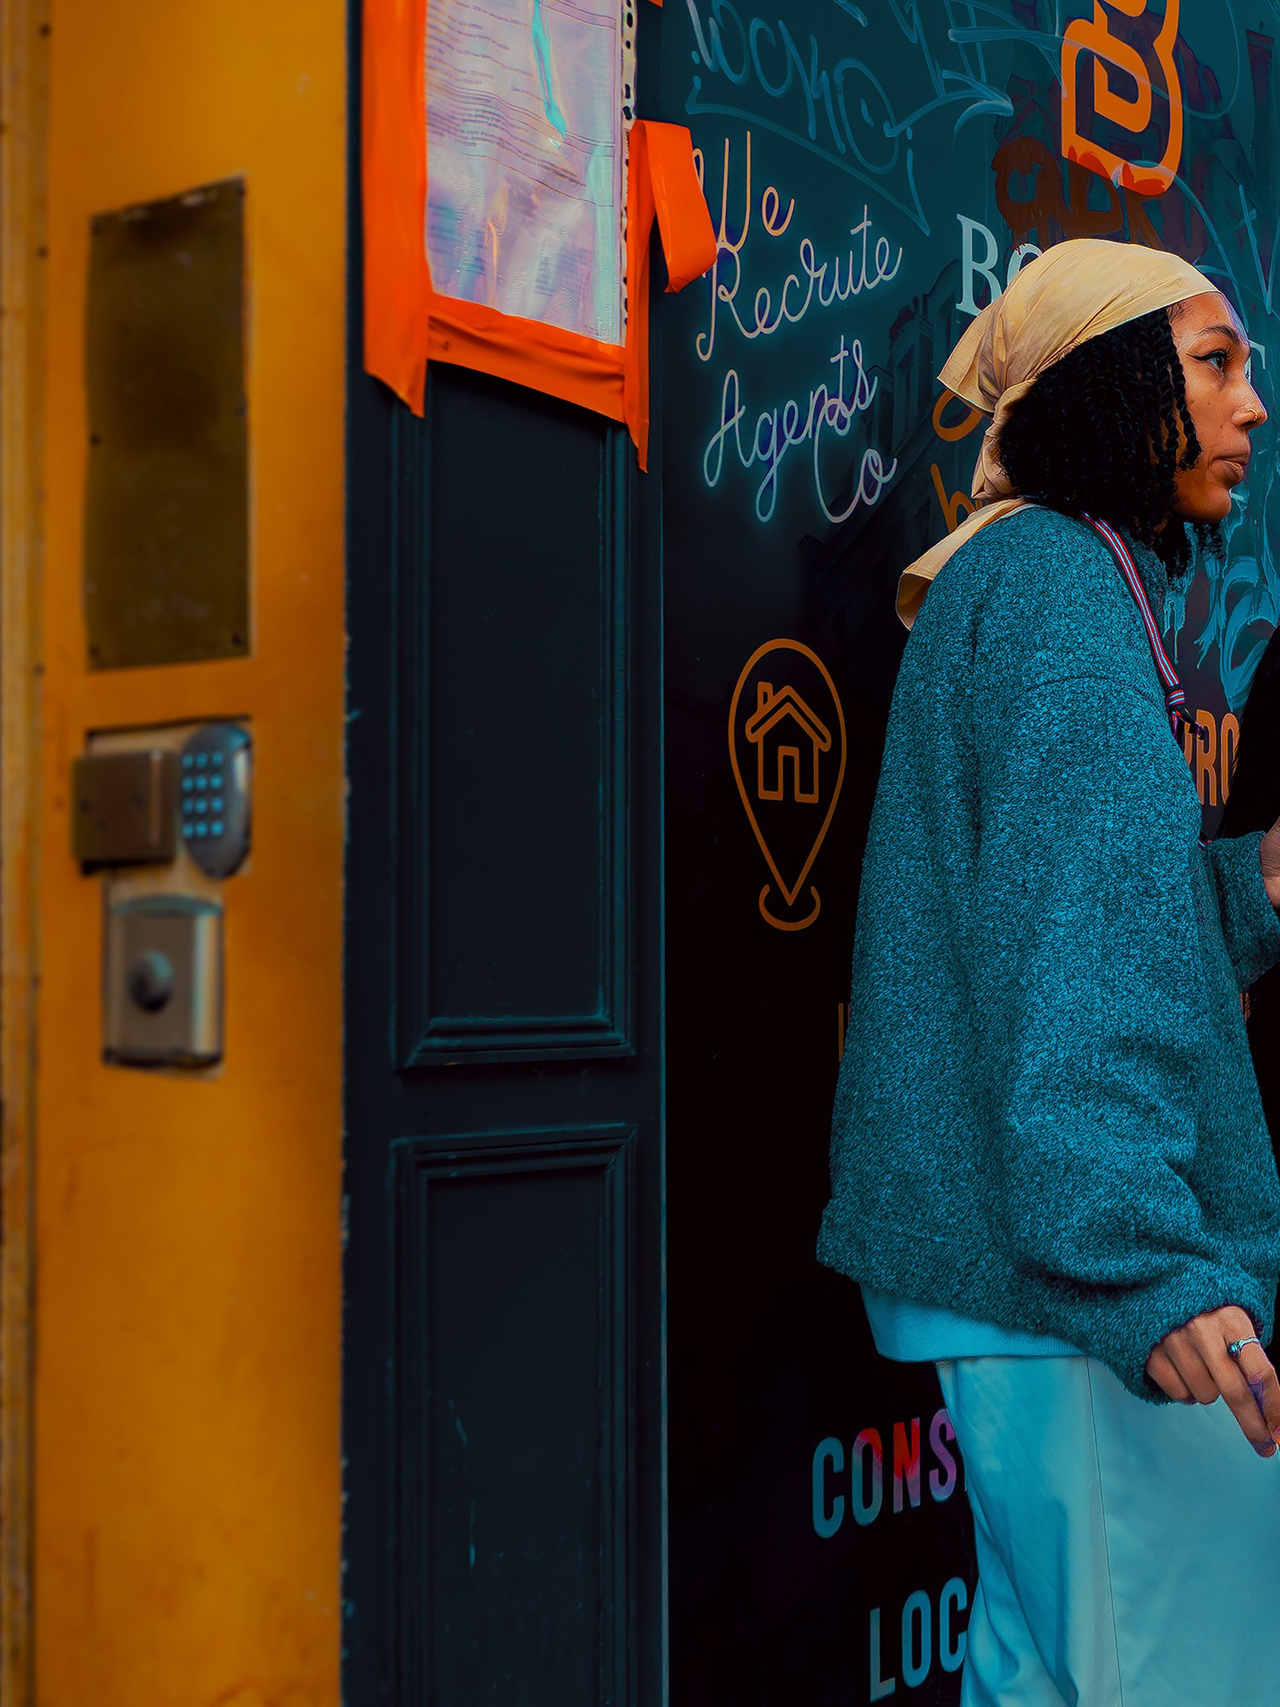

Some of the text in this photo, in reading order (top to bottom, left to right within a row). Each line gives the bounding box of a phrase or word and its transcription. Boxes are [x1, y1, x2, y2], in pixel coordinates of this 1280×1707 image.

[692, 131, 796, 254] We
[697, 204, 903, 361] Recrute
[704, 335, 878, 523] Agents
